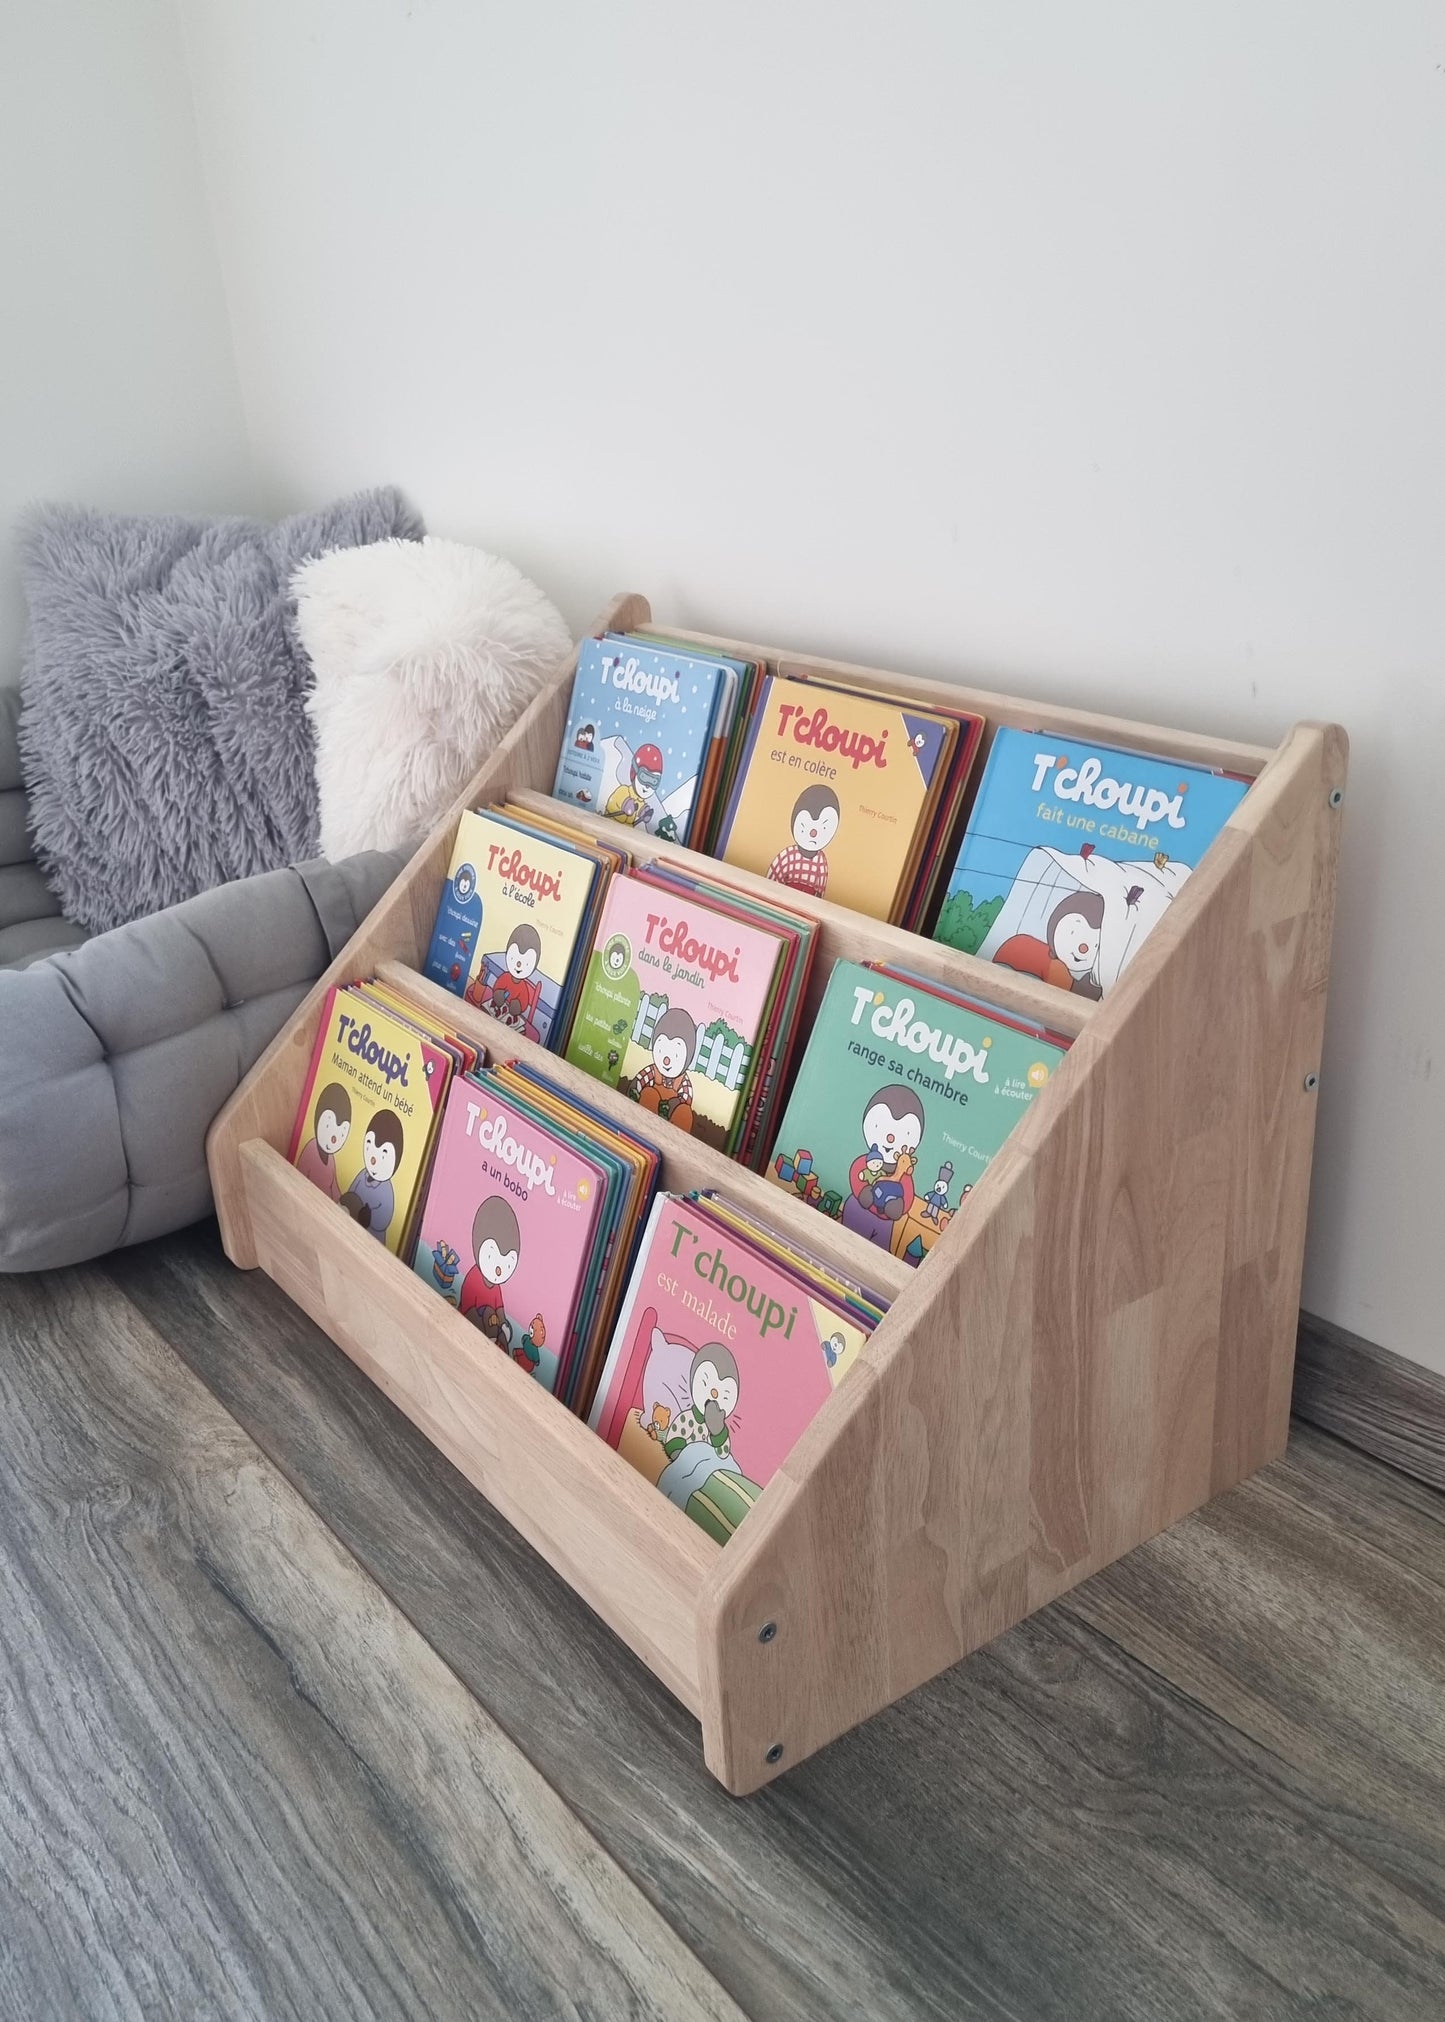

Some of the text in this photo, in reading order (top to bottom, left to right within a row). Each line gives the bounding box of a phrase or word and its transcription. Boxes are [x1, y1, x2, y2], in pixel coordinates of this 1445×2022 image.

[602, 657, 681, 706] T'choupi
[615, 697, 657, 723] à la neige
[778, 704, 889, 770] T'choupi
[770, 749, 837, 780] est en colère
[1031, 753, 1188, 830] T'choupi
[1036, 803, 1160, 849] fait une cabane
[487, 844, 563, 902] T'choupi
[502, 882, 535, 908] à l'école
[638, 947, 660, 968] dans
[662, 955, 672, 973] le
[671, 964, 705, 989] jardin
[645, 914, 741, 983] T'choupi
[337, 1014, 411, 1087] T'choupi
[850, 986, 993, 1084] T'choupi
[332, 1052, 414, 1117] Maman attend un bébé
[847, 1039, 969, 1106] range sa chambre
[994, 1084, 1033, 1101] à écouter
[1005, 1077, 1026, 1090] à lire
[466, 1101, 557, 1196] T'choupi
[942, 1131, 968, 1153] Thierry
[481, 1160, 528, 1202] a un bobo
[656, 1270, 737, 1340] est malade
